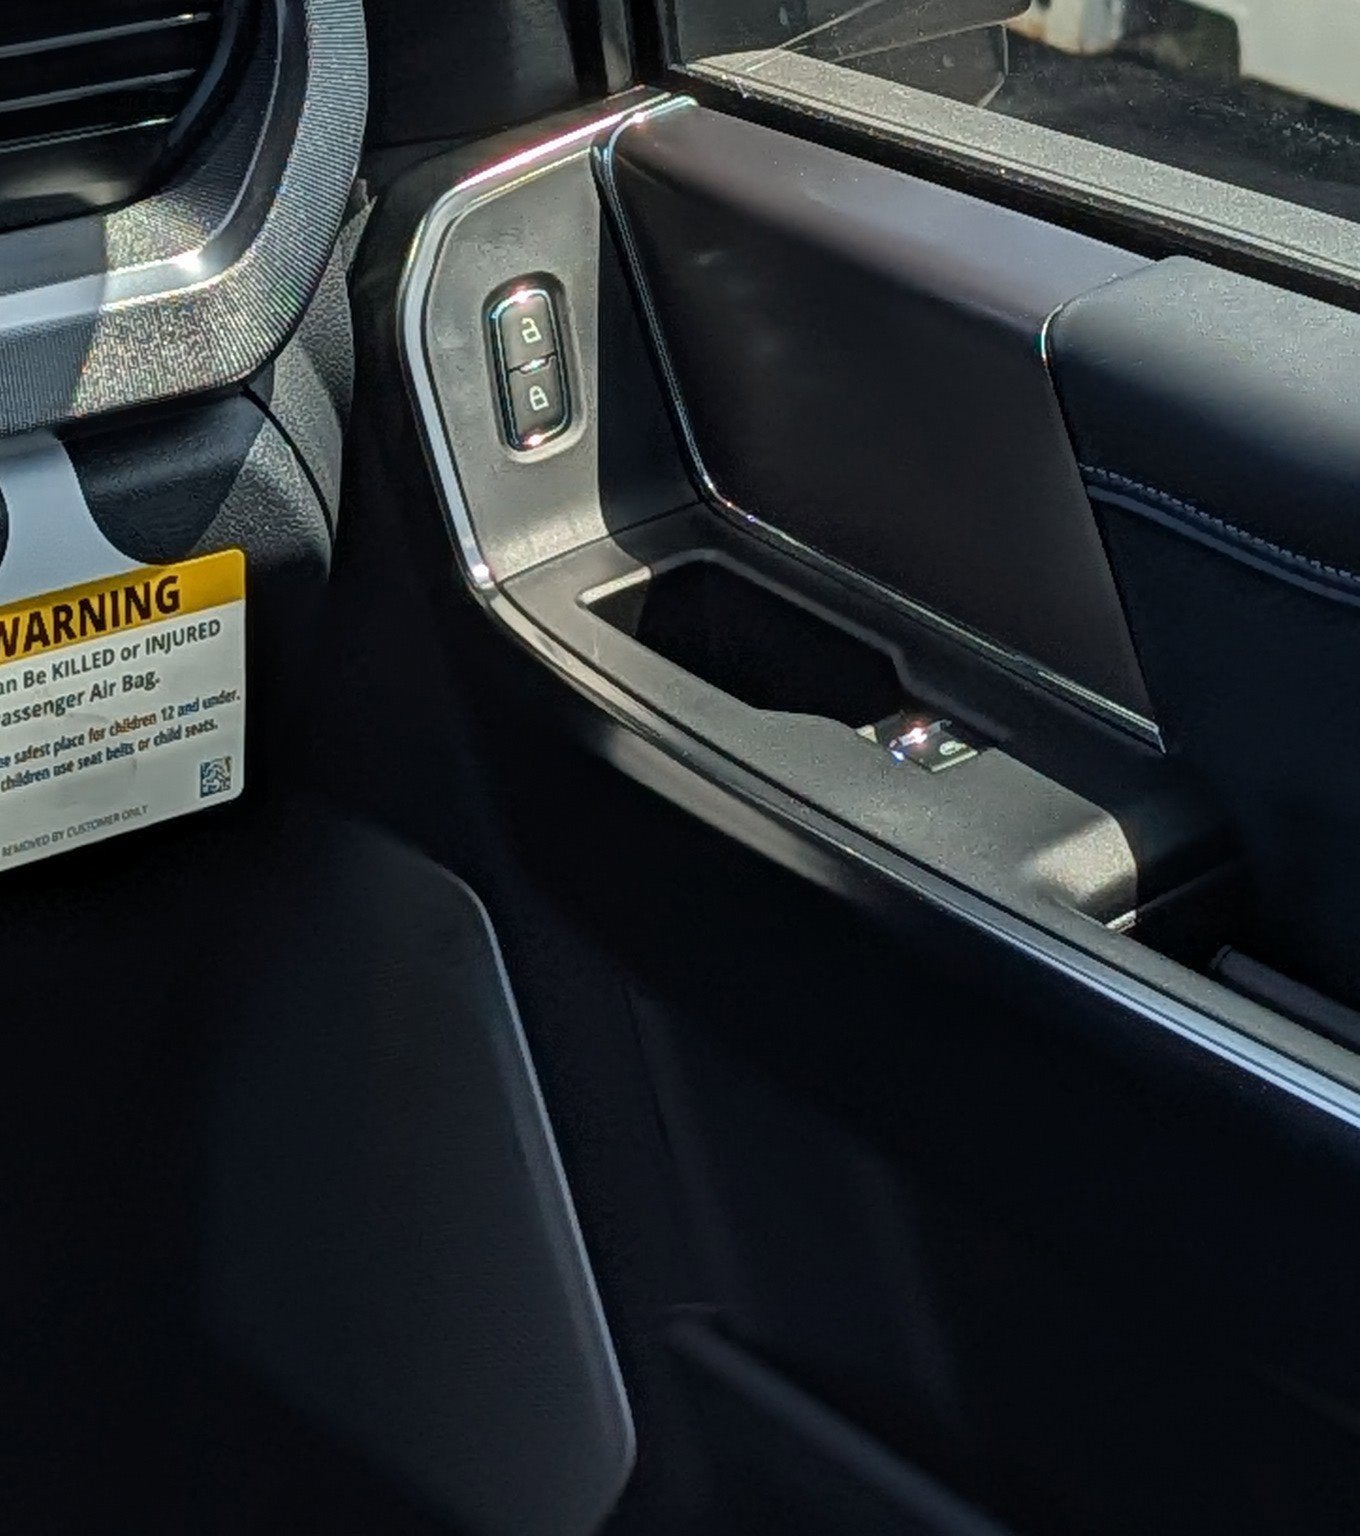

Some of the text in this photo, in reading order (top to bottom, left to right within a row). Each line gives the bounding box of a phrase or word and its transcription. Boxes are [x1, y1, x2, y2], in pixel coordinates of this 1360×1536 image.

[23, 669, 47, 689] Be
[51, 648, 115, 681] KILLED
[120, 643, 140, 661] or
[145, 619, 221, 655] INJURED
[90, 680, 116, 702] Air
[122, 671, 160, 693] Bag.
[0, 767, 50, 792] children
[53, 760, 75, 777] use
[77, 750, 103, 770] seat
[105, 742, 135, 761] belts
[138, 737, 150, 752] or
[153, 725, 182, 747] child
[185, 718, 218, 739] seats.
[14, 743, 51, 764] safest
[53, 733, 84, 757] place
[88, 726, 106, 743] for
[109, 713, 157, 736] children
[160, 705, 175, 721] 12
[177, 697, 200, 716] and
[202, 689, 241, 710] under.
[52, 829, 65, 843] BY
[67, 812, 120, 838] CUSTOMER
